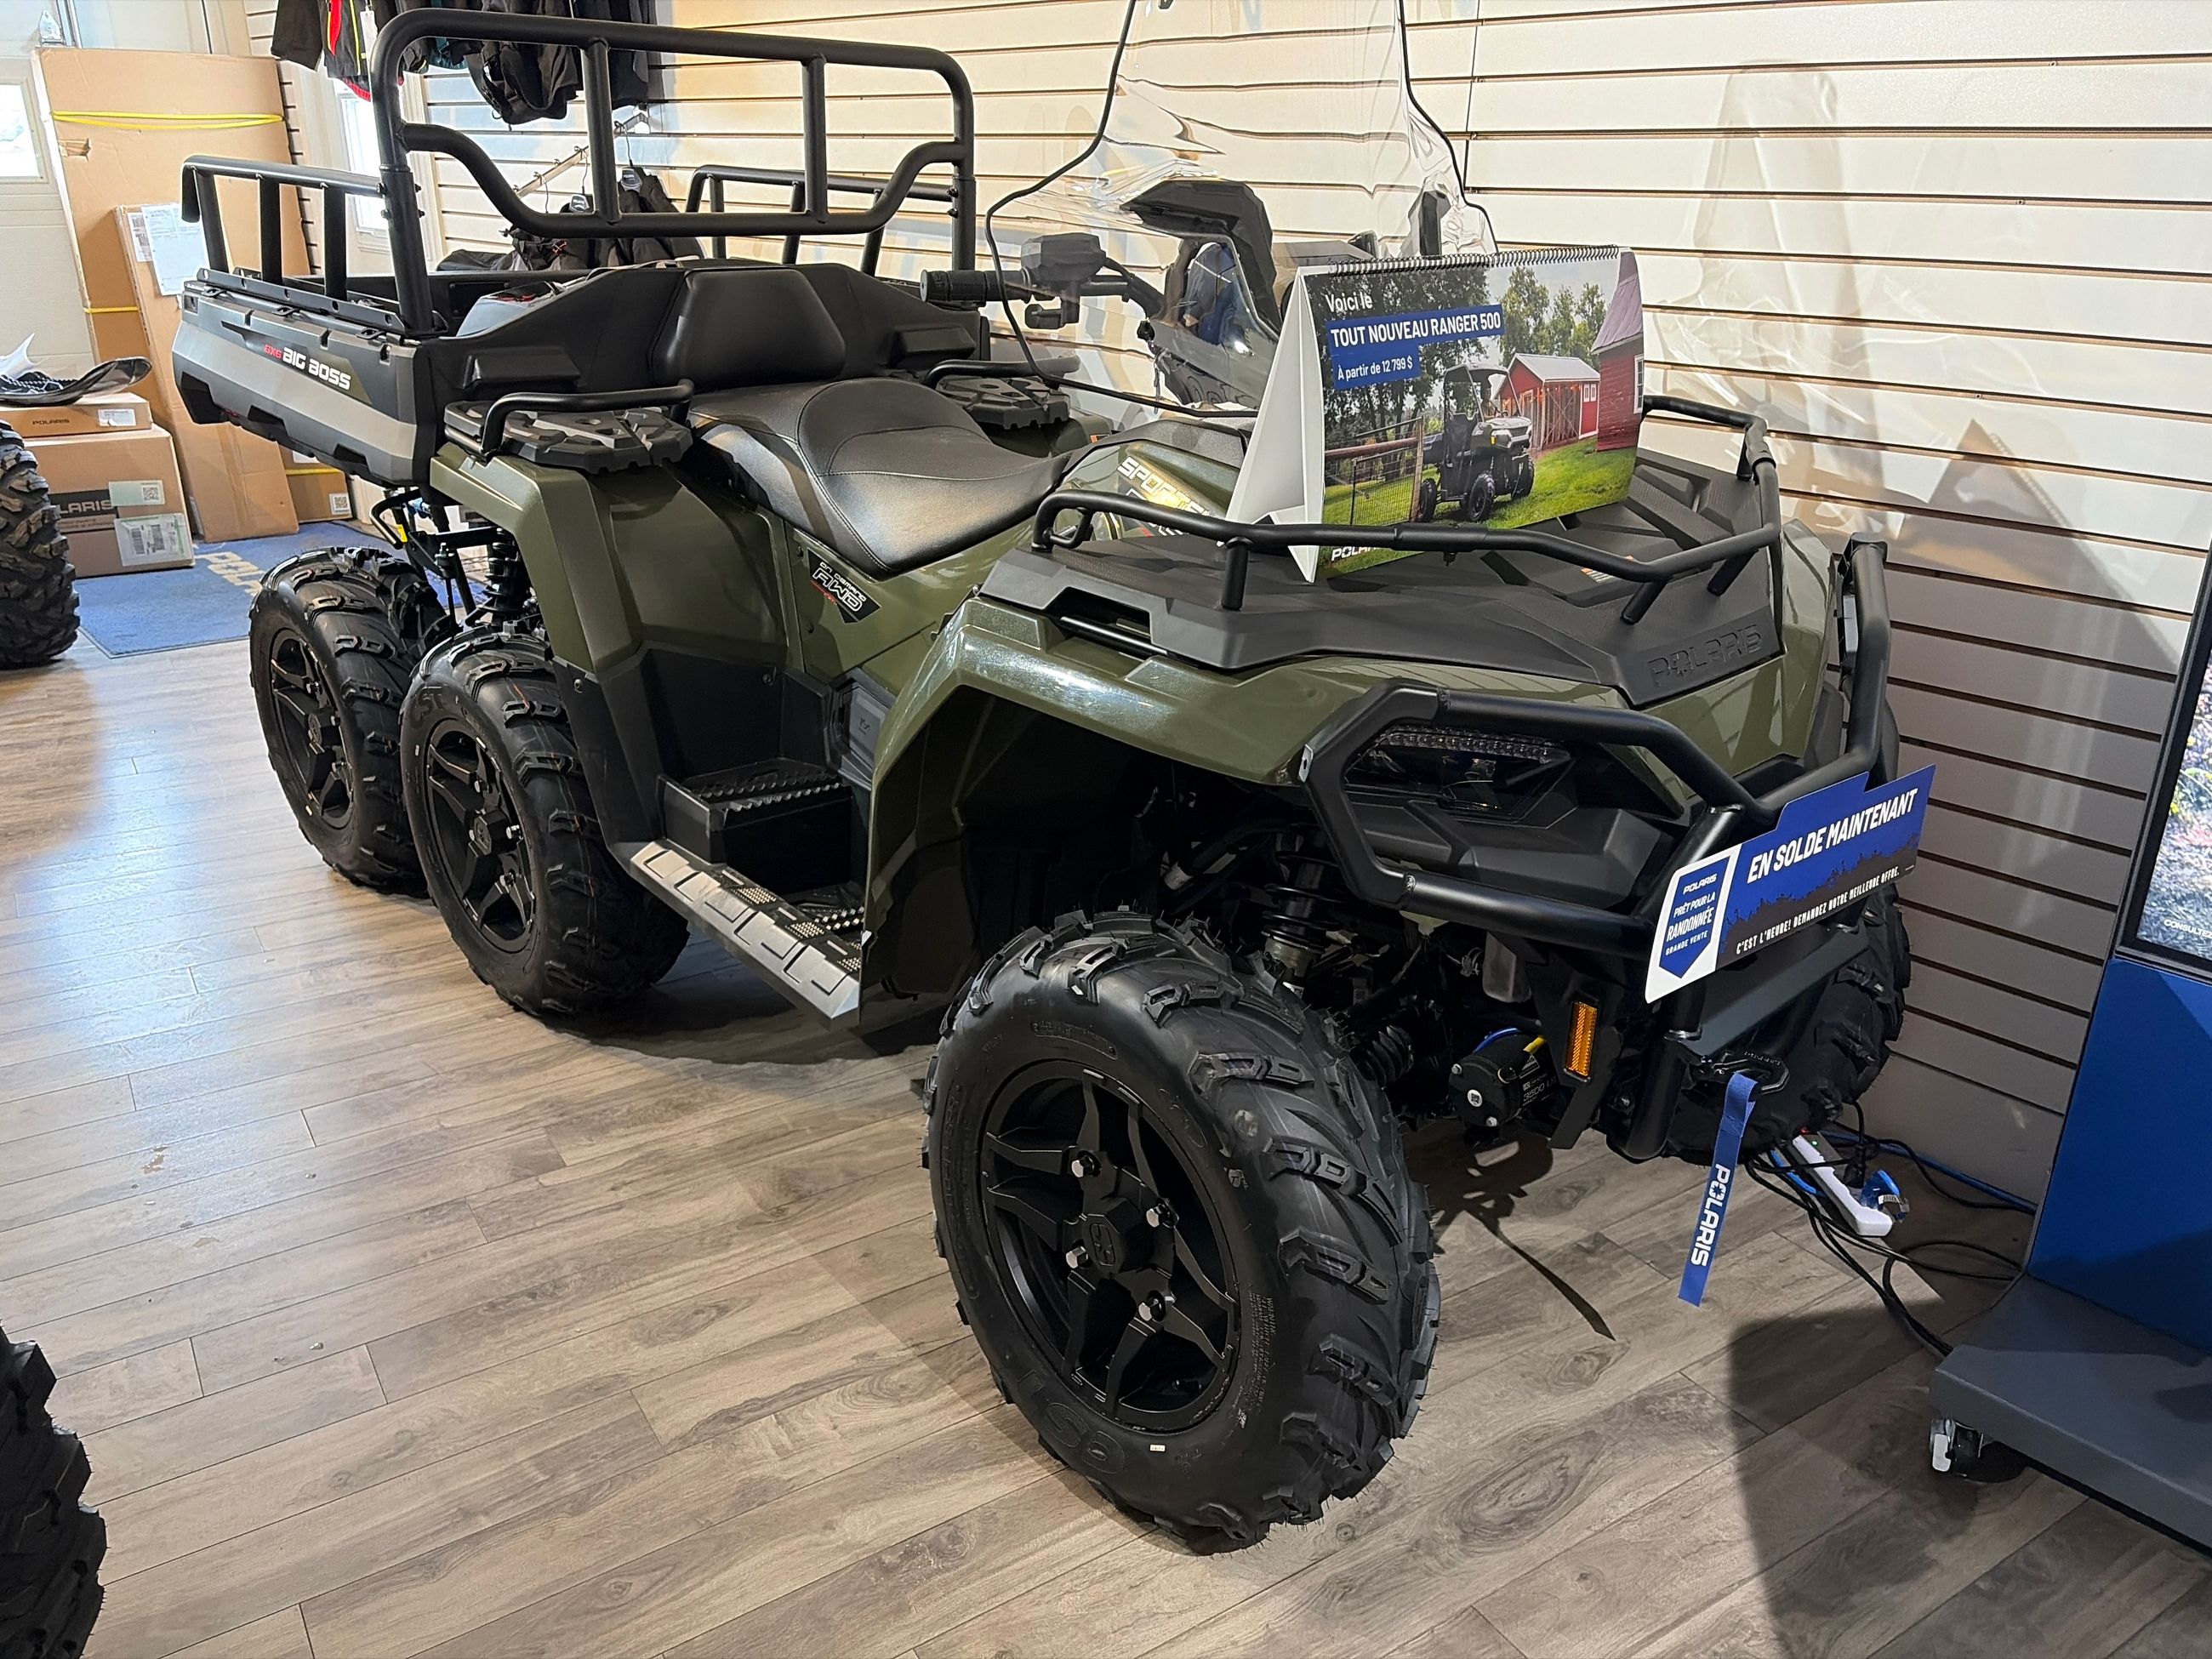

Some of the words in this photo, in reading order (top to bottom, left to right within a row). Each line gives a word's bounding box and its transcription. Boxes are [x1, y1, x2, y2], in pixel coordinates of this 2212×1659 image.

[1325, 294, 1358, 312] Voici
[1360, 293, 1373, 310] le
[1331, 327, 1365, 348] TOUT
[1368, 317, 1428, 344] NOUVEAU
[1431, 314, 1479, 336] RANGER
[1480, 311, 1502, 330] 500
[282, 346, 306, 370] BIG
[308, 358, 351, 391] BOSS
[1337, 365, 1345, 380] À
[1346, 363, 1369, 381] partir
[1370, 361, 1381, 375] de
[1407, 355, 1413, 370] $
[812, 567, 863, 612] AWD
[1747, 849, 1774, 884] EN
[1773, 827, 1827, 872] SOLDE
[1825, 788, 1918, 849] MAINTENANT
[1683, 874, 1718, 895] POLARIS
[1673, 902, 1691, 919] PRÊT
[1690, 896, 1707, 912] POUR
[1703, 892, 1716, 905] LA
[1736, 935, 1757, 955] C'EST
[1759, 919, 1791, 944] L'HEURE!
[1793, 902, 1827, 928] DEMANDEZ
[1828, 893, 1848, 911] NOTRE
[1850, 878, 1880, 900] MEILLEURE
[1881, 866, 1899, 884] OFFRE.
[1667, 907, 1714, 942] RANDONNÉE
[1666, 938, 1689, 956] GRANDE
[1690, 930, 1708, 945] VENTE
[1690, 1163, 1730, 1267] POLARIS
